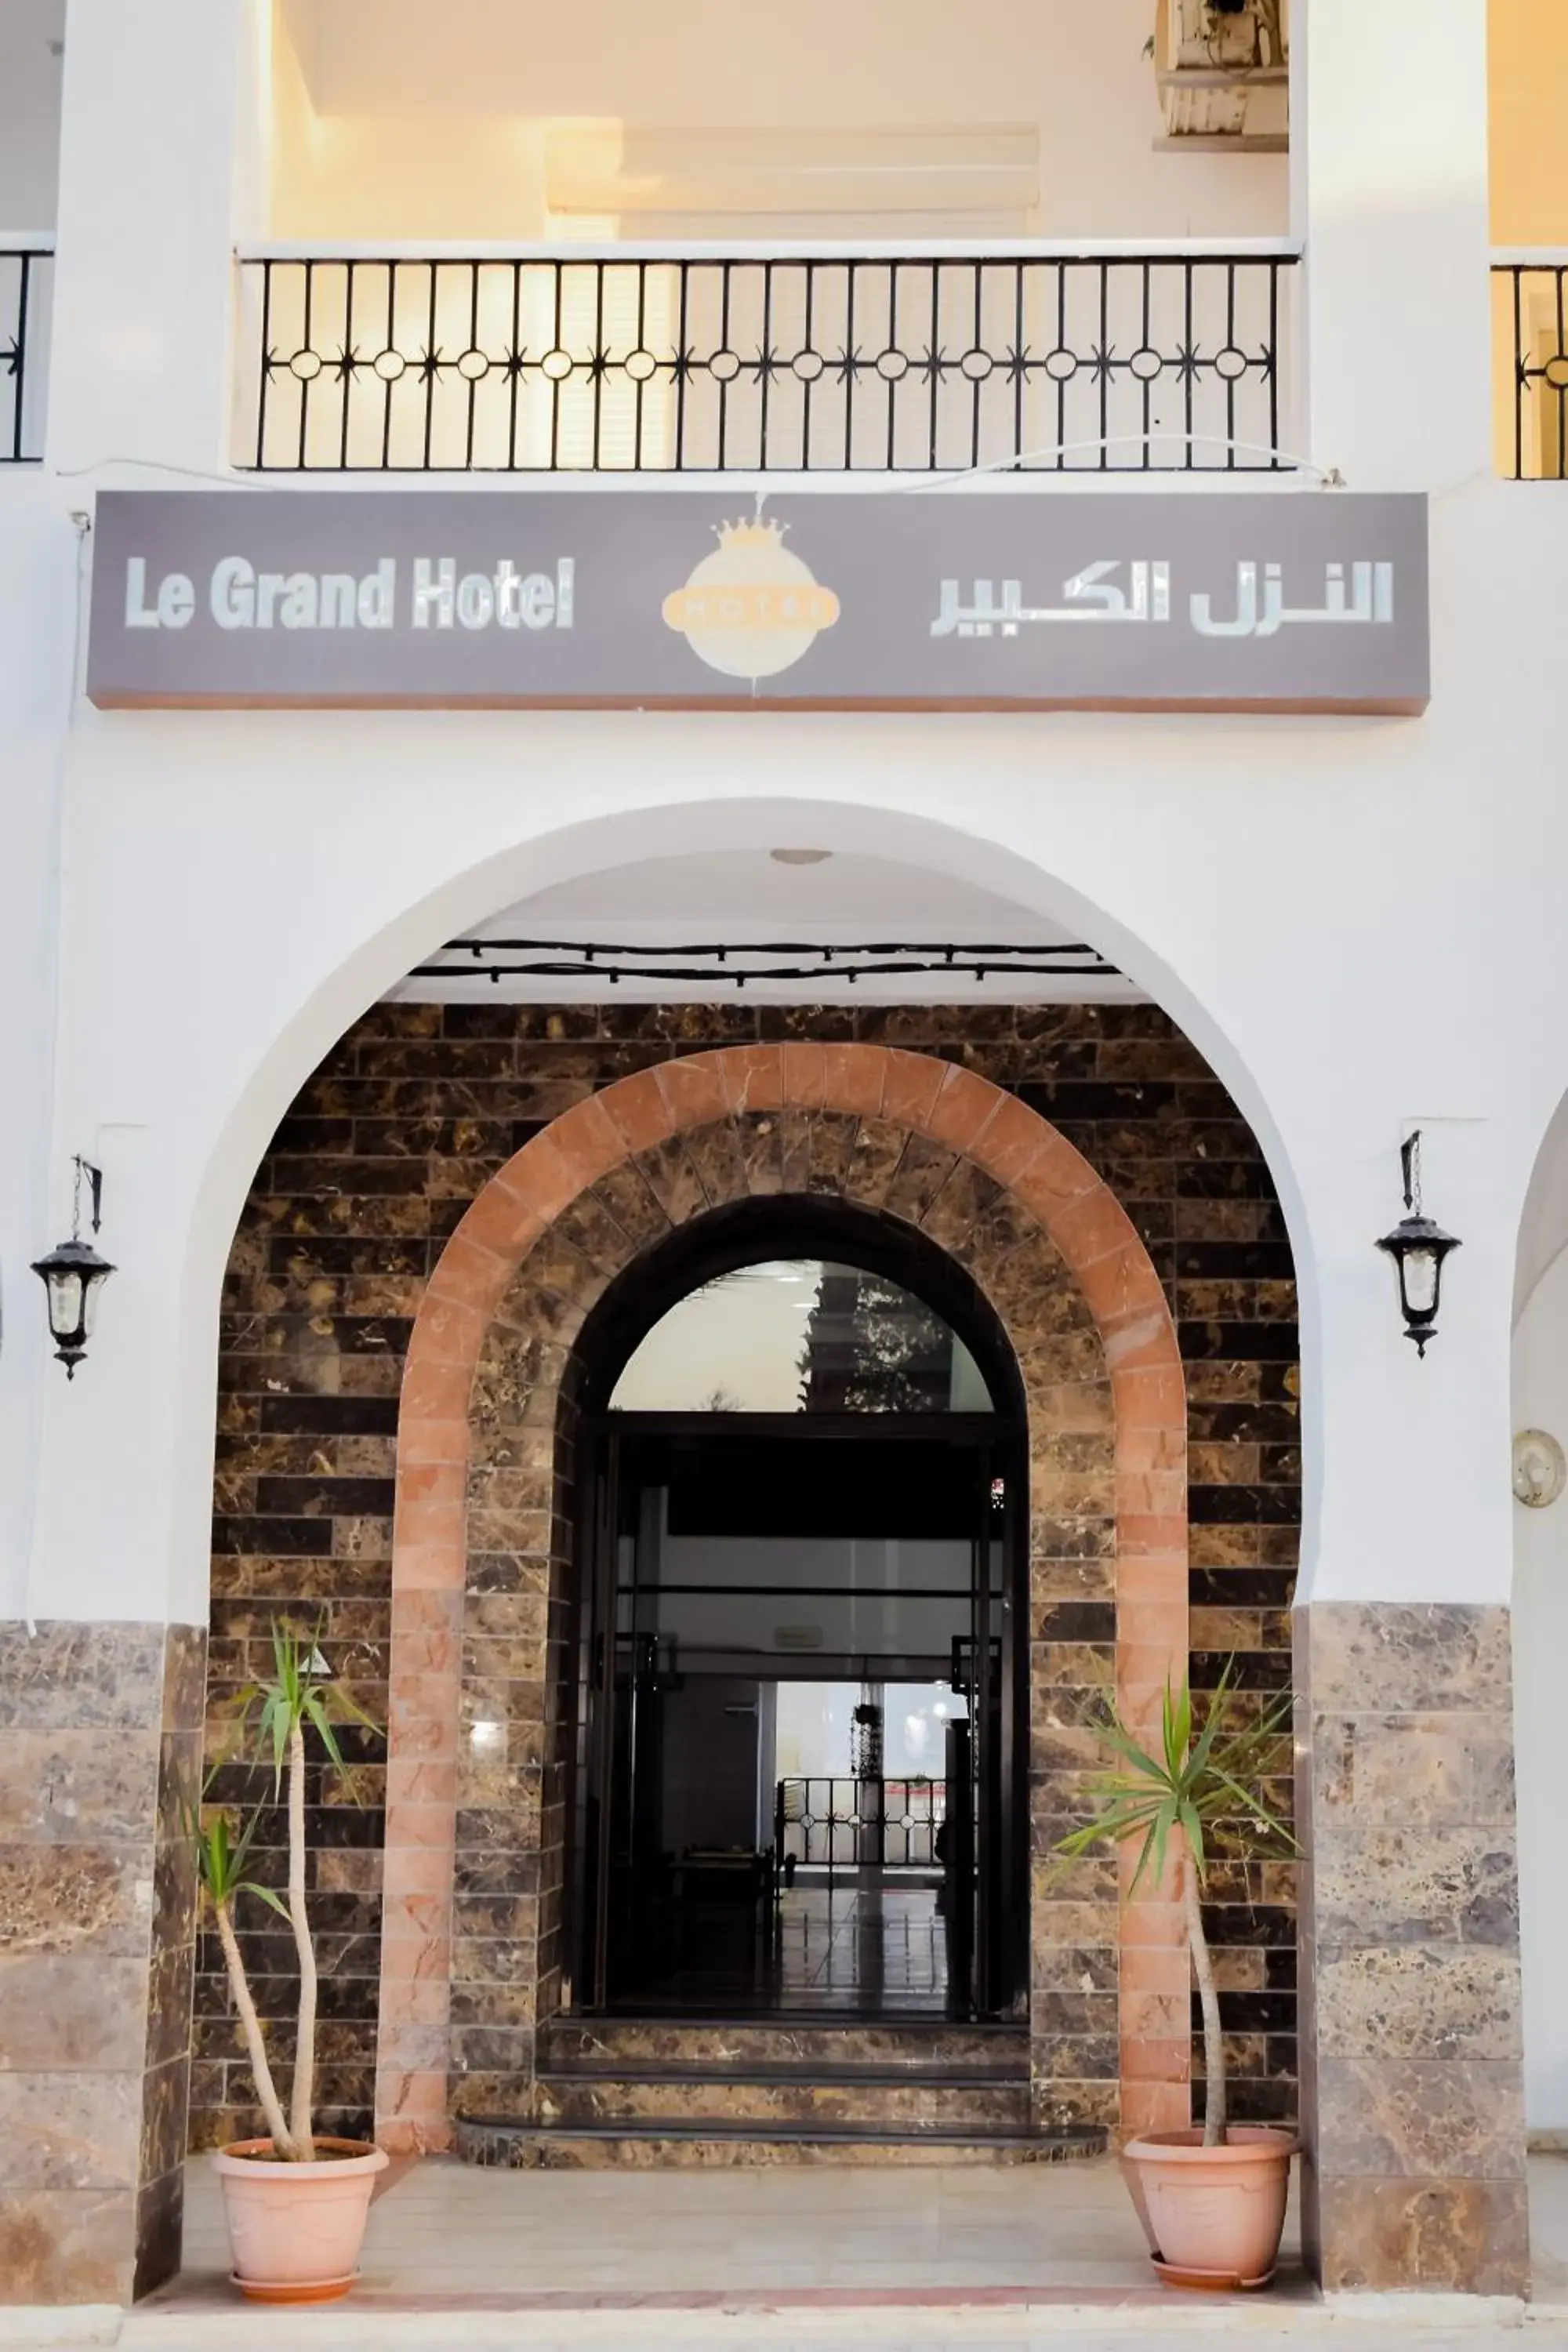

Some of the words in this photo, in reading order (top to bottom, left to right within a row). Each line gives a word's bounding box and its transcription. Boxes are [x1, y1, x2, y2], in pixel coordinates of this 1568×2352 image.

[125, 556, 195, 629] Le
[209, 555, 396, 630] Grand
[411, 556, 575, 630] Hotel
[930, 560, 1171, 637] الكبير
[1189, 560, 1394, 637] النزل
